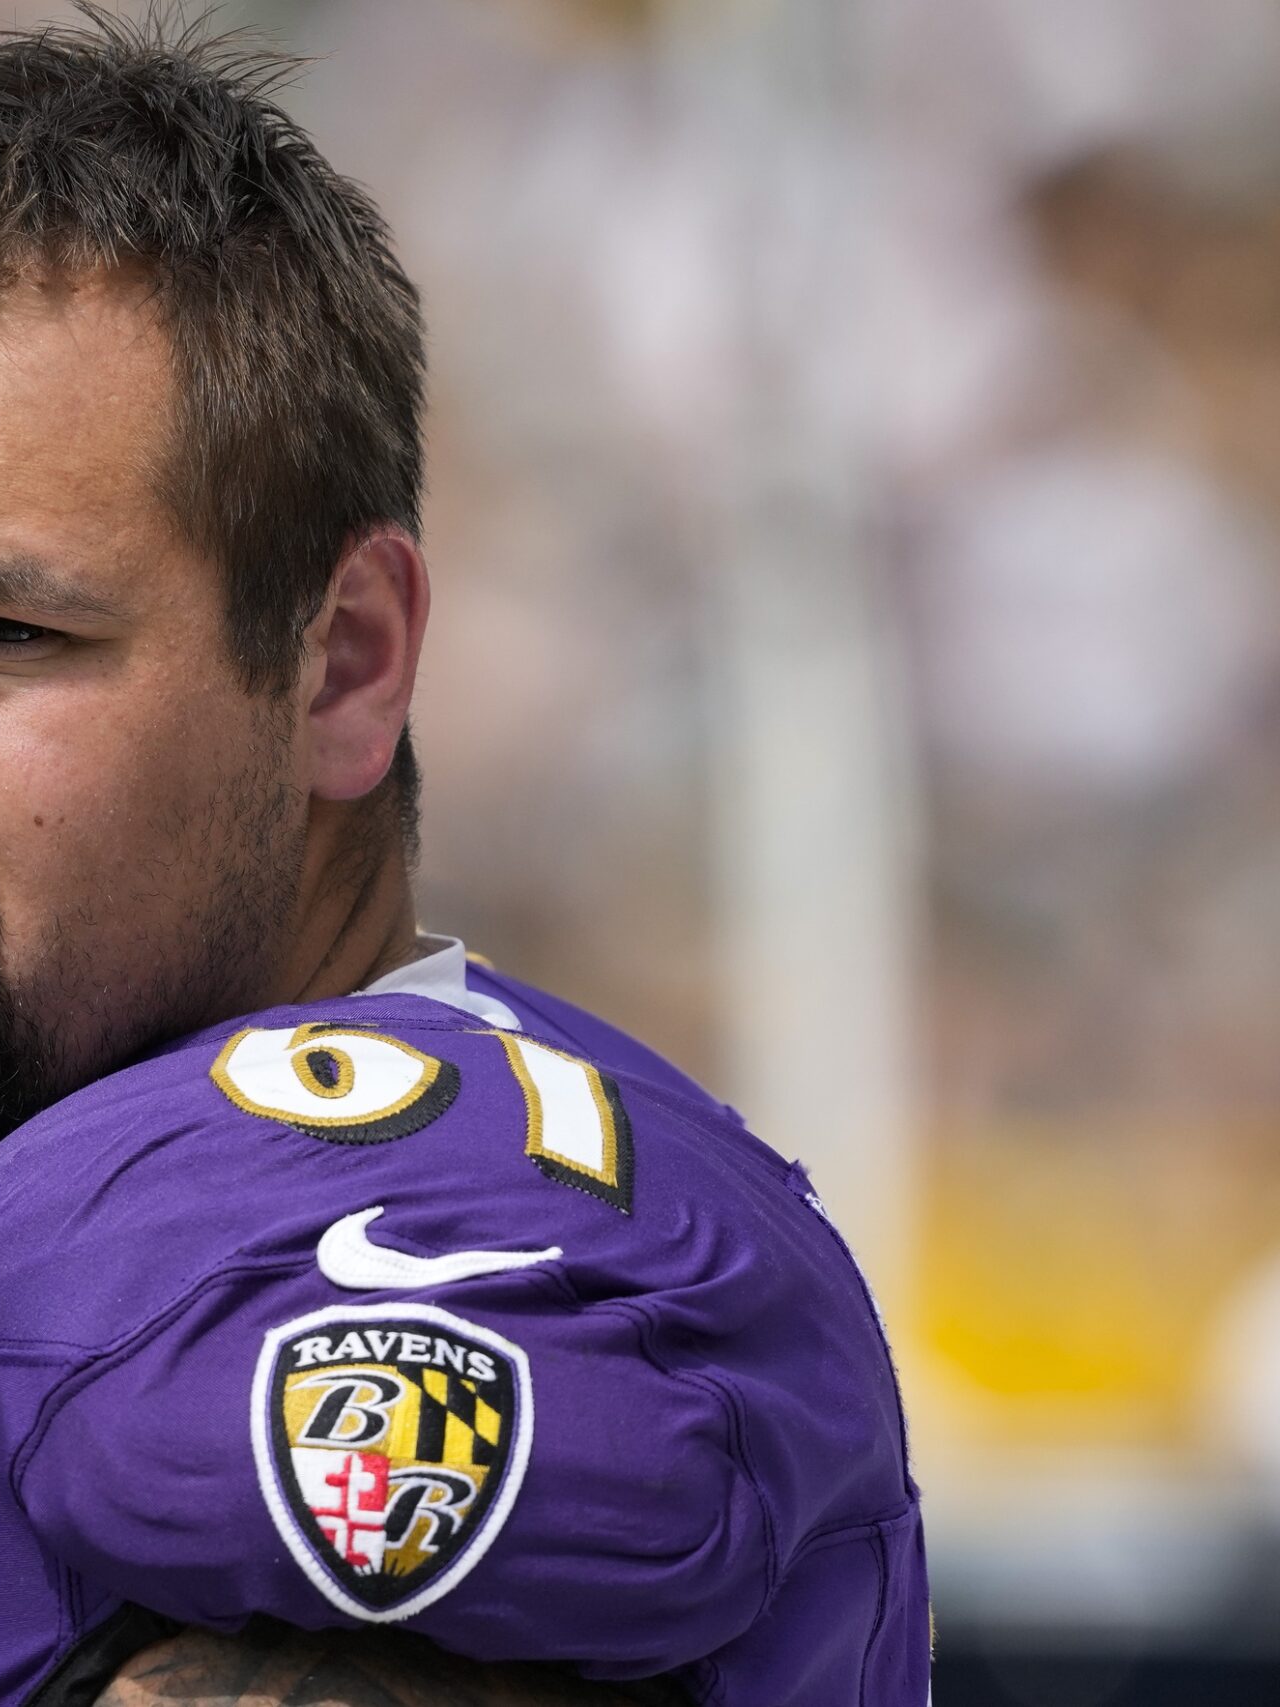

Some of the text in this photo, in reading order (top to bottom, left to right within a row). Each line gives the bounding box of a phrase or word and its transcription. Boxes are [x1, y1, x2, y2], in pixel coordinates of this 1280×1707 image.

[292, 1330, 496, 1382] RAVENS
[288, 1368, 406, 1449] B
[383, 1465, 476, 1553] R
